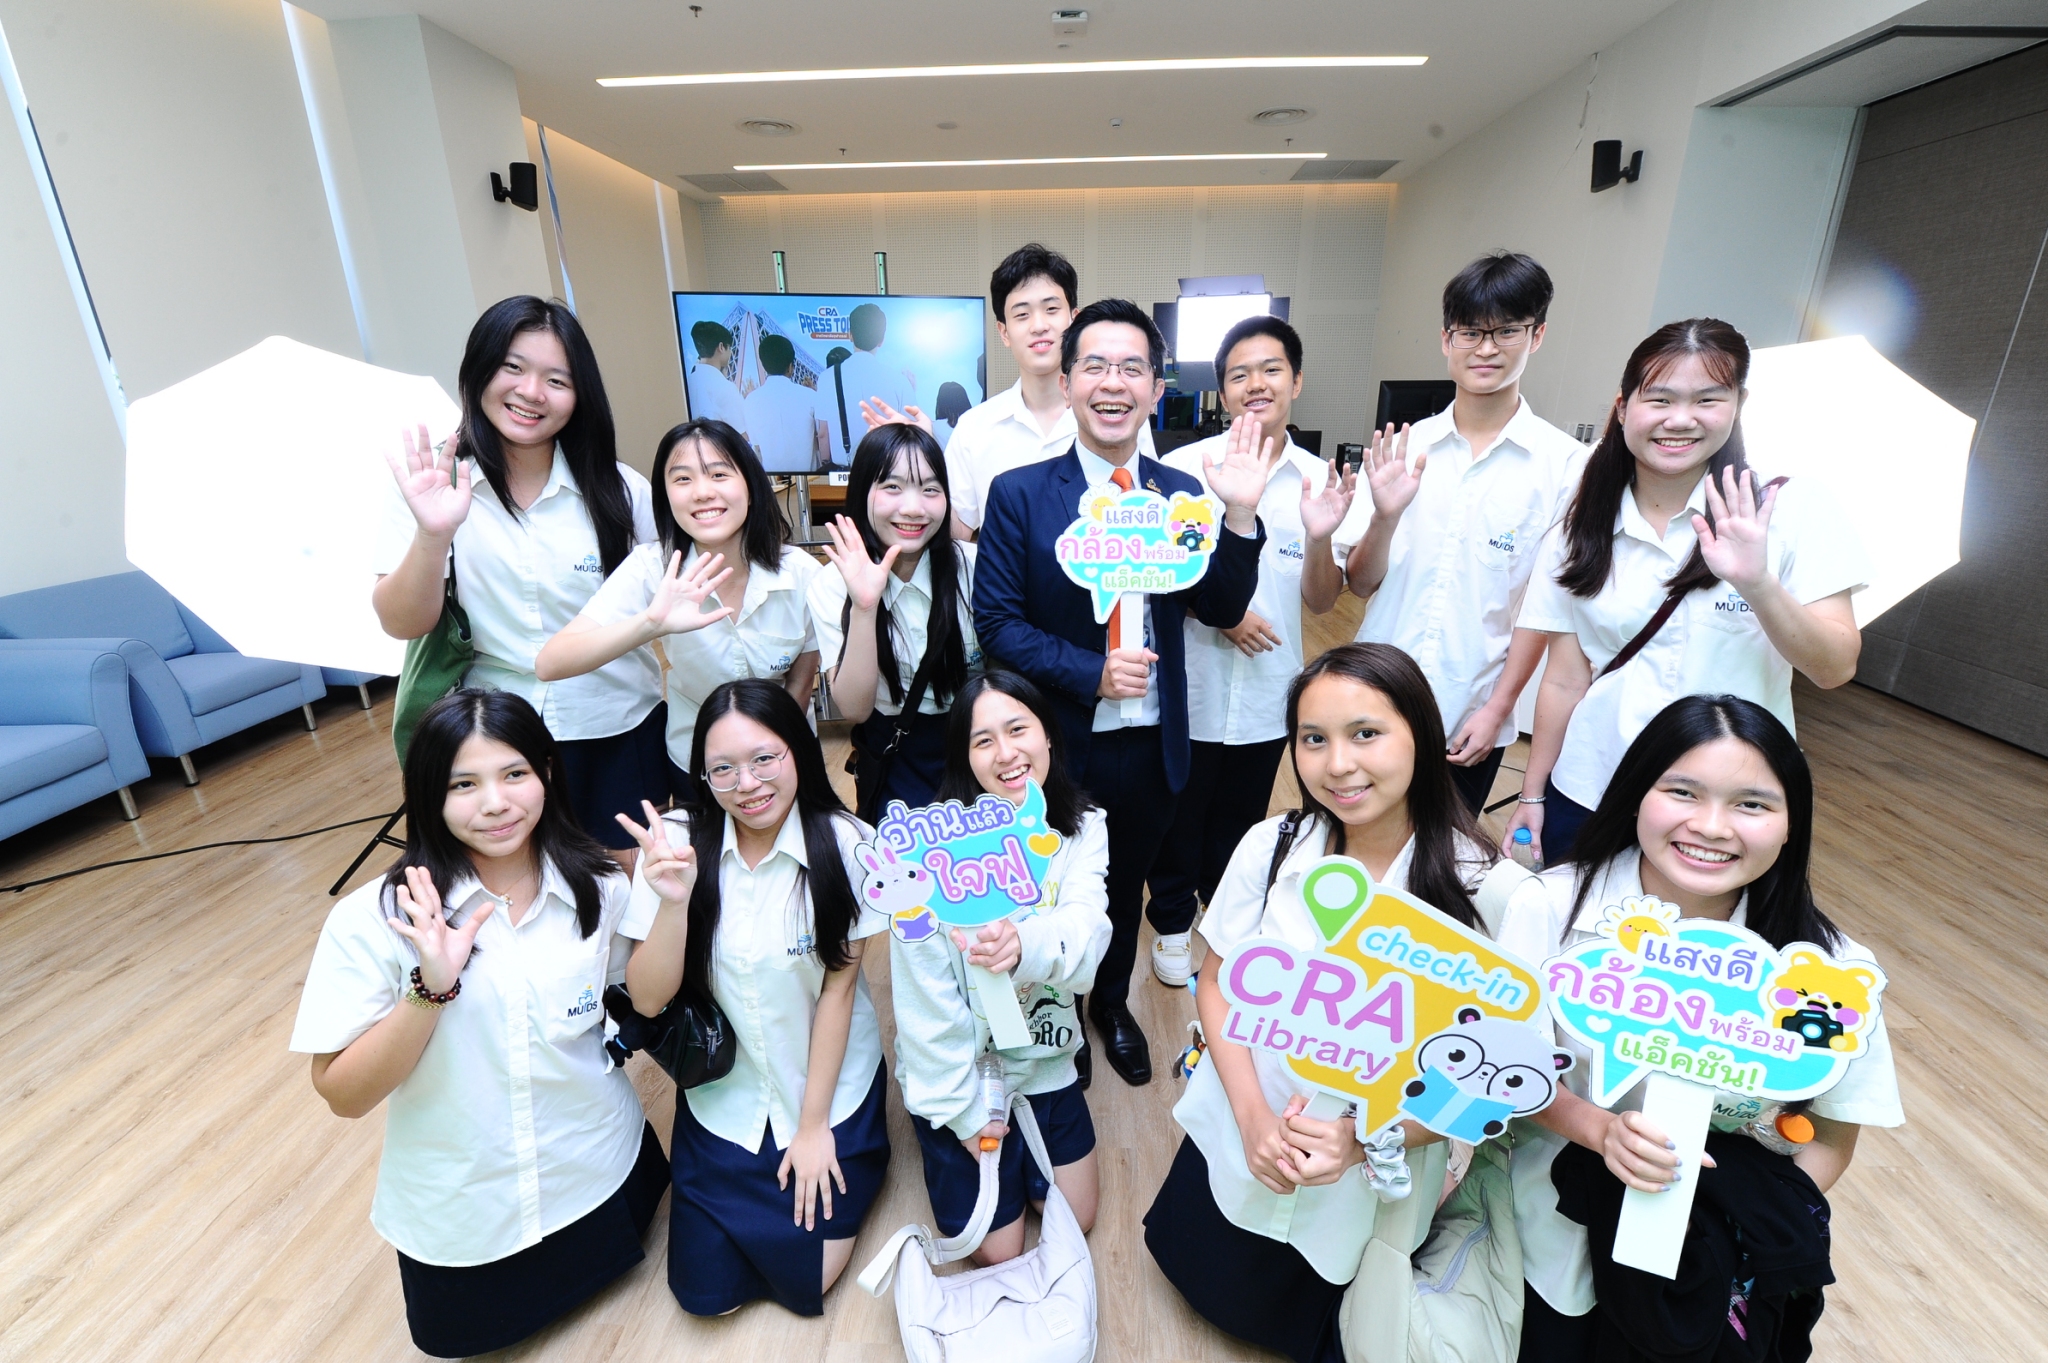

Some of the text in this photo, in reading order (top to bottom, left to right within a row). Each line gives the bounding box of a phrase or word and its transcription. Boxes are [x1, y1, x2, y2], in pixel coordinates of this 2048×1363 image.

[798, 312, 832, 334] PRESS
[819, 307, 838, 316] CRA
[1105, 503, 1160, 525] แสงดี
[928, 840, 1035, 901] ใจฟู
[1364, 930, 1522, 1005] check-in
[1644, 939, 1758, 985] แสงดี
[1229, 946, 1403, 1044] CRA
[1227, 1011, 1391, 1080] Library
